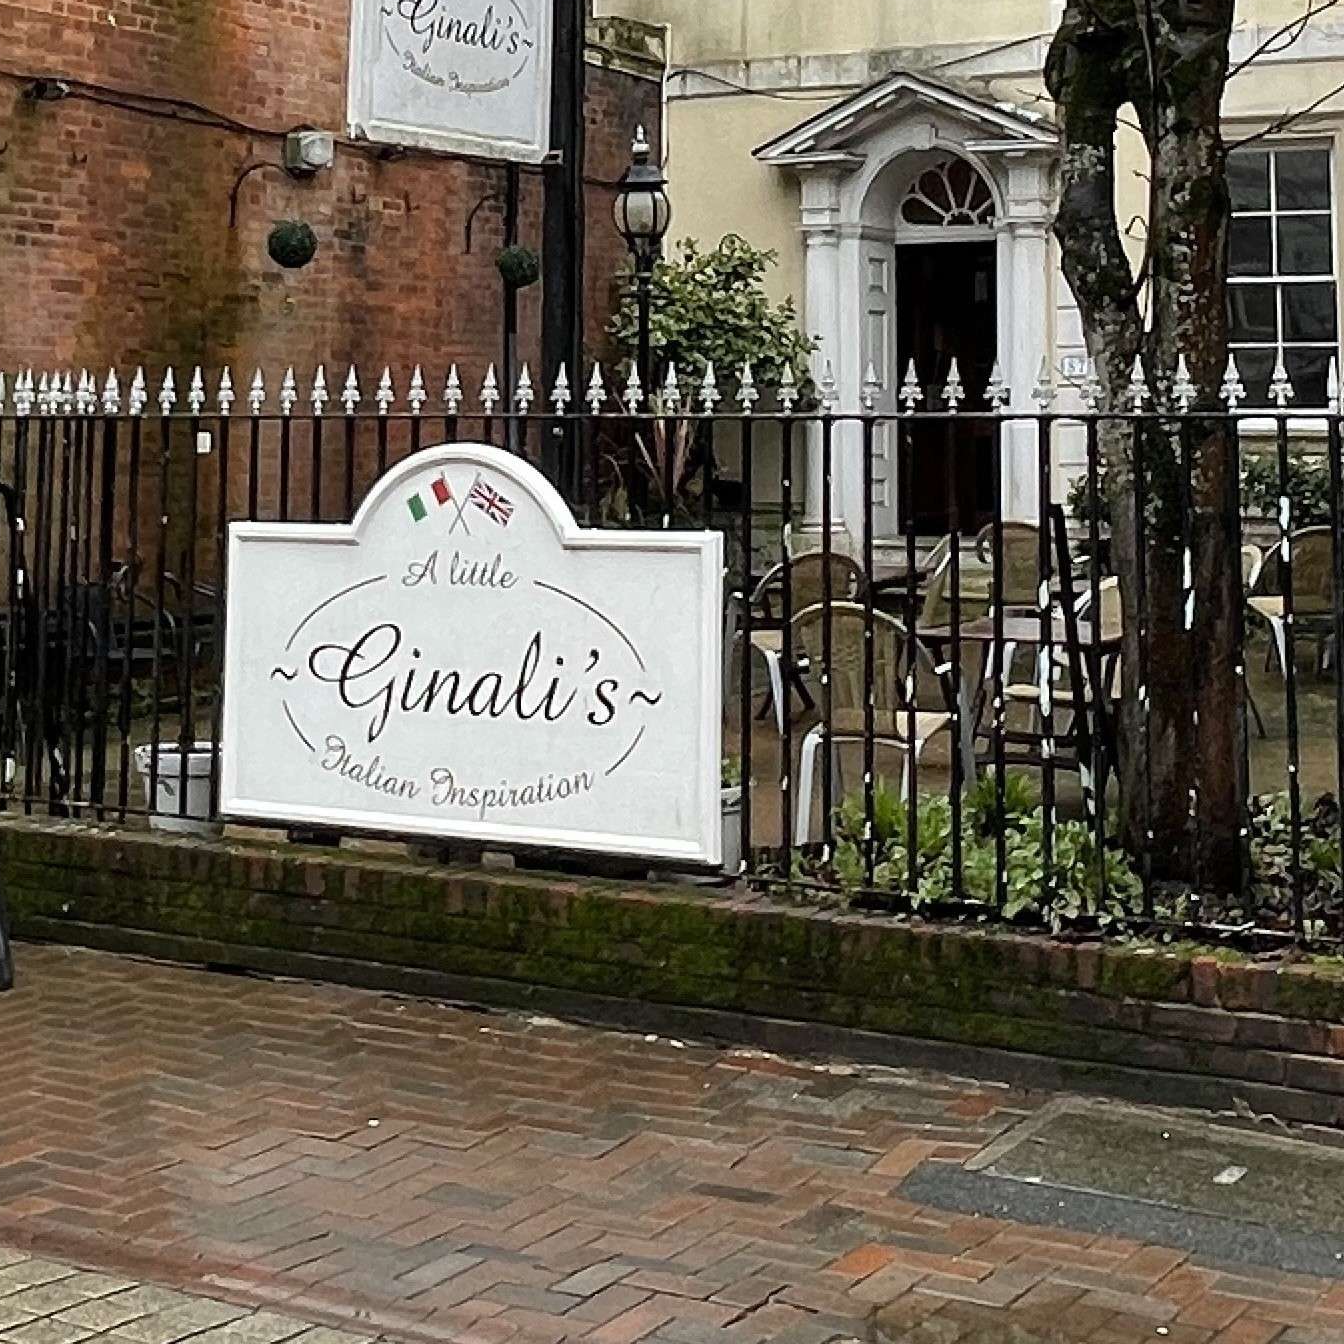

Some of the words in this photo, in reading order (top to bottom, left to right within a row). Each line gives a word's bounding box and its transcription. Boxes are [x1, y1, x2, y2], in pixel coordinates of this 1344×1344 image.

[402, 551, 438, 586] A
[449, 551, 517, 588] little
[308, 623, 618, 743] Ginali's
[321, 736, 420, 798] Italian
[430, 768, 595, 820] Inspiration
